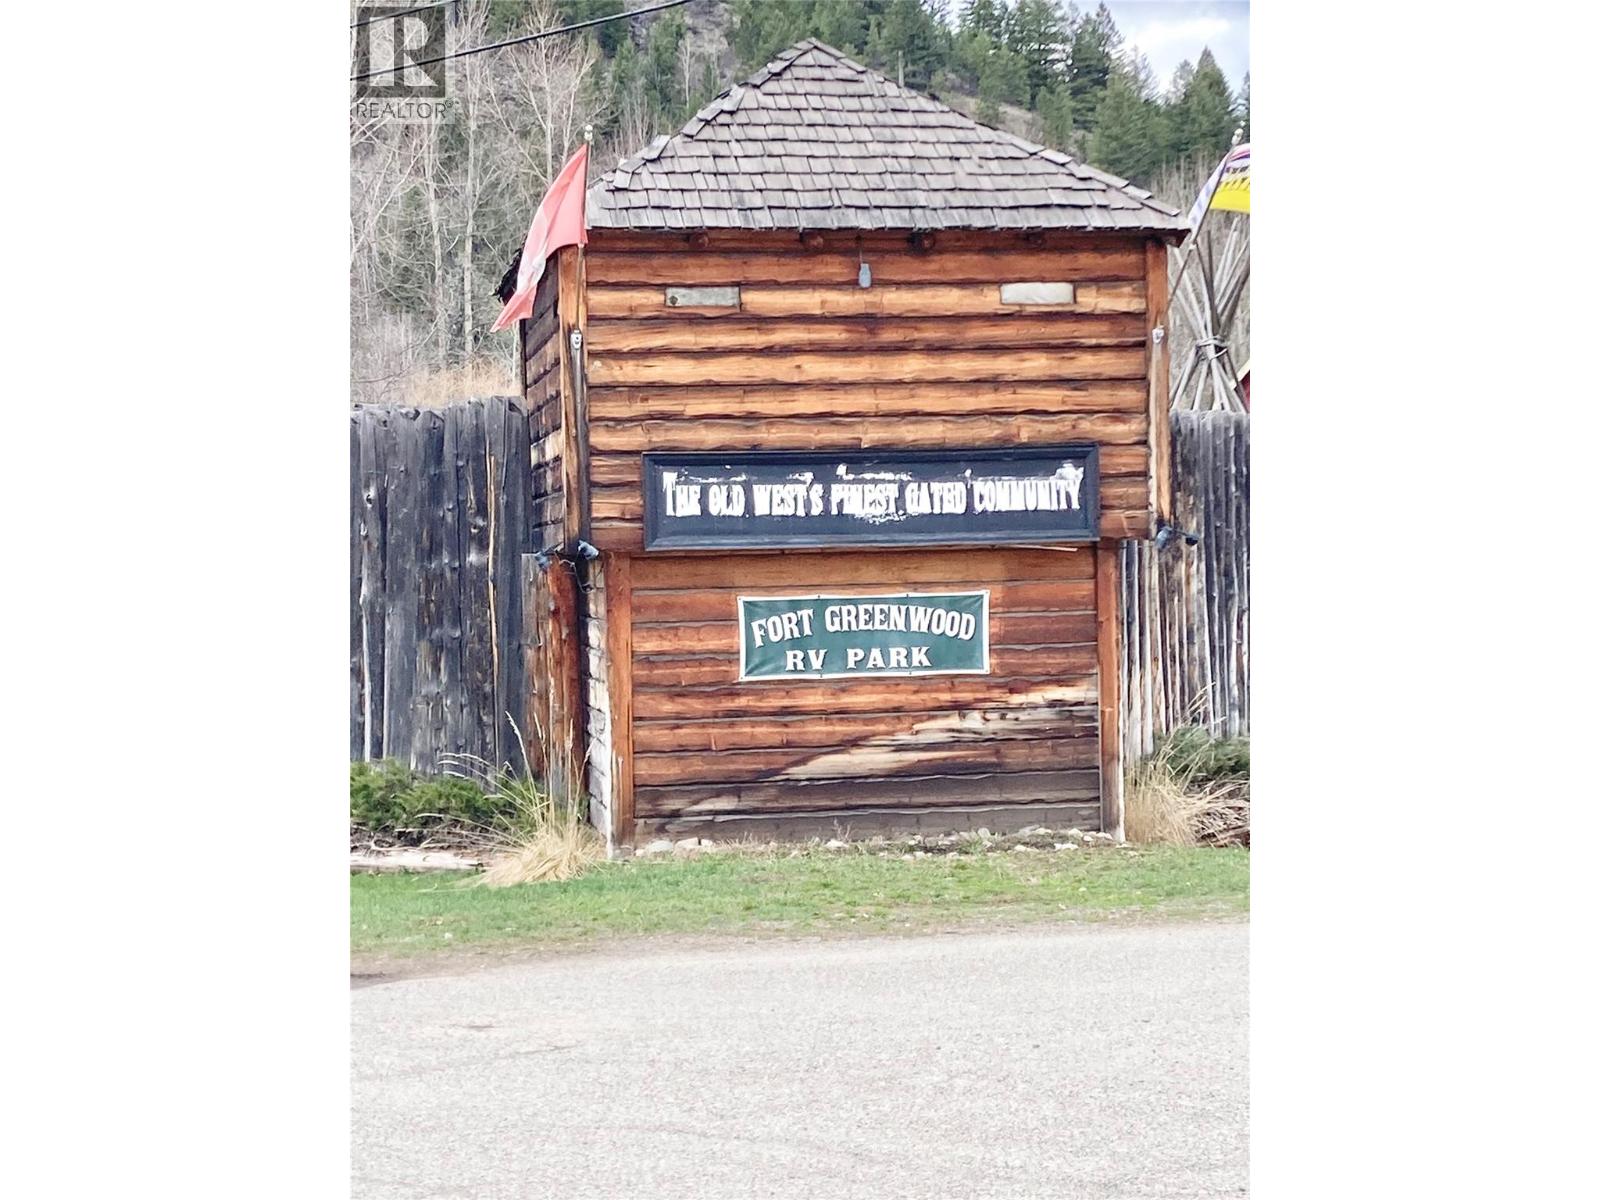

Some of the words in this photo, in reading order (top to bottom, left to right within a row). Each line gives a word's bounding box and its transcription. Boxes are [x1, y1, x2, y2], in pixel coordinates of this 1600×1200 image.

[708, 484, 745, 517] OLD
[752, 478, 823, 517] WEST'S
[905, 482, 967, 514] GATED
[973, 470, 1083, 513] COMMUNITY
[751, 609, 814, 648] FORT
[825, 604, 976, 641] GREENWOOD
[785, 650, 827, 671] RV
[847, 646, 931, 670] PARK
